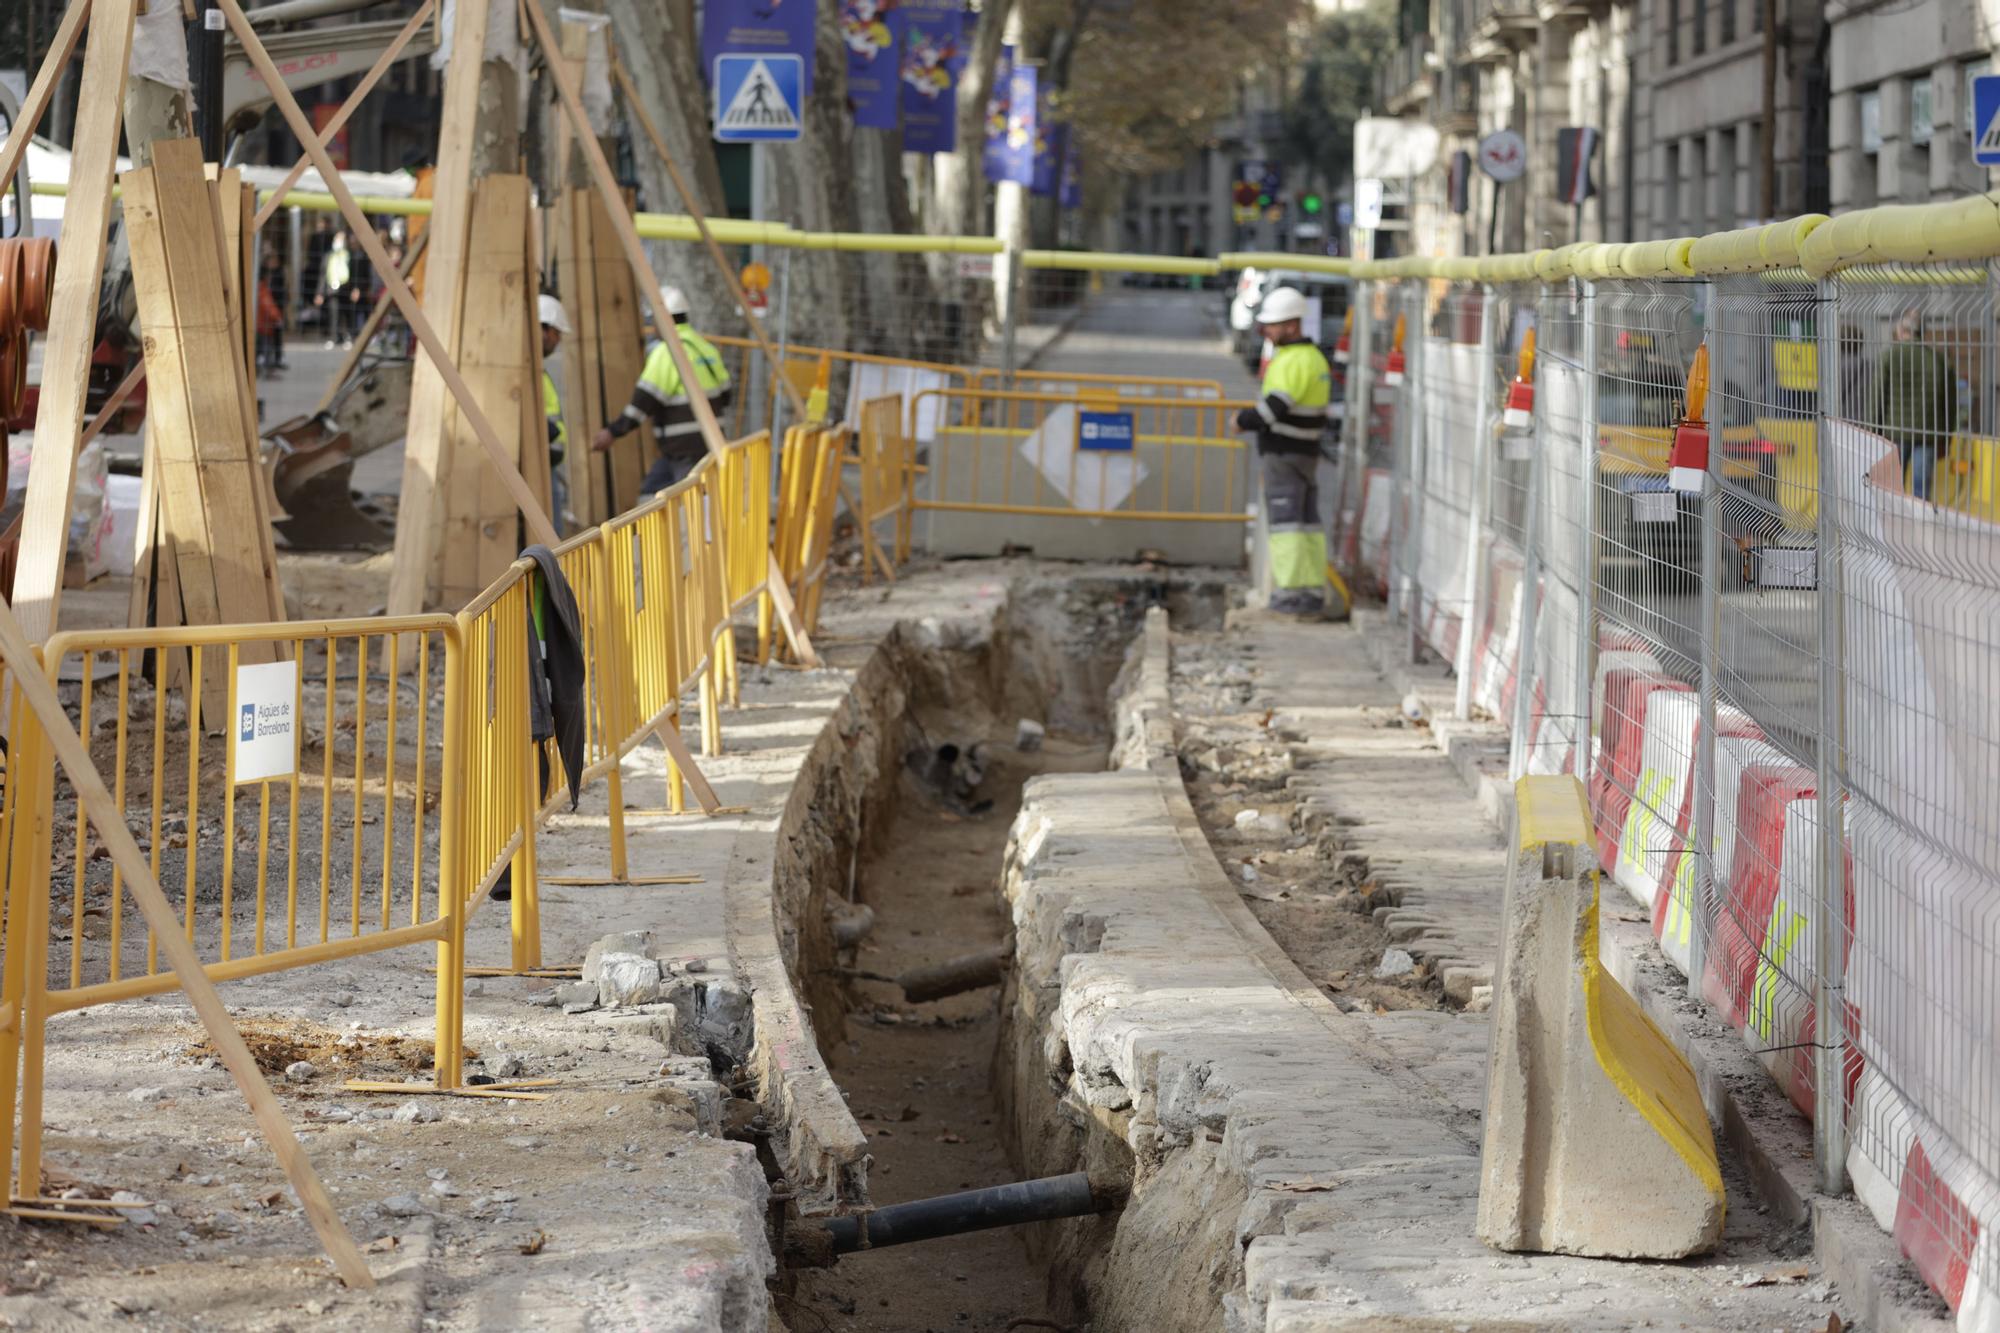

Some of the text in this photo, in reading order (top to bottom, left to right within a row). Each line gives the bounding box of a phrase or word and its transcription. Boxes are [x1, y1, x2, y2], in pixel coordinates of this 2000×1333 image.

[258, 702, 289, 722] Aigües de
[258, 721, 289, 736] Barcelona
